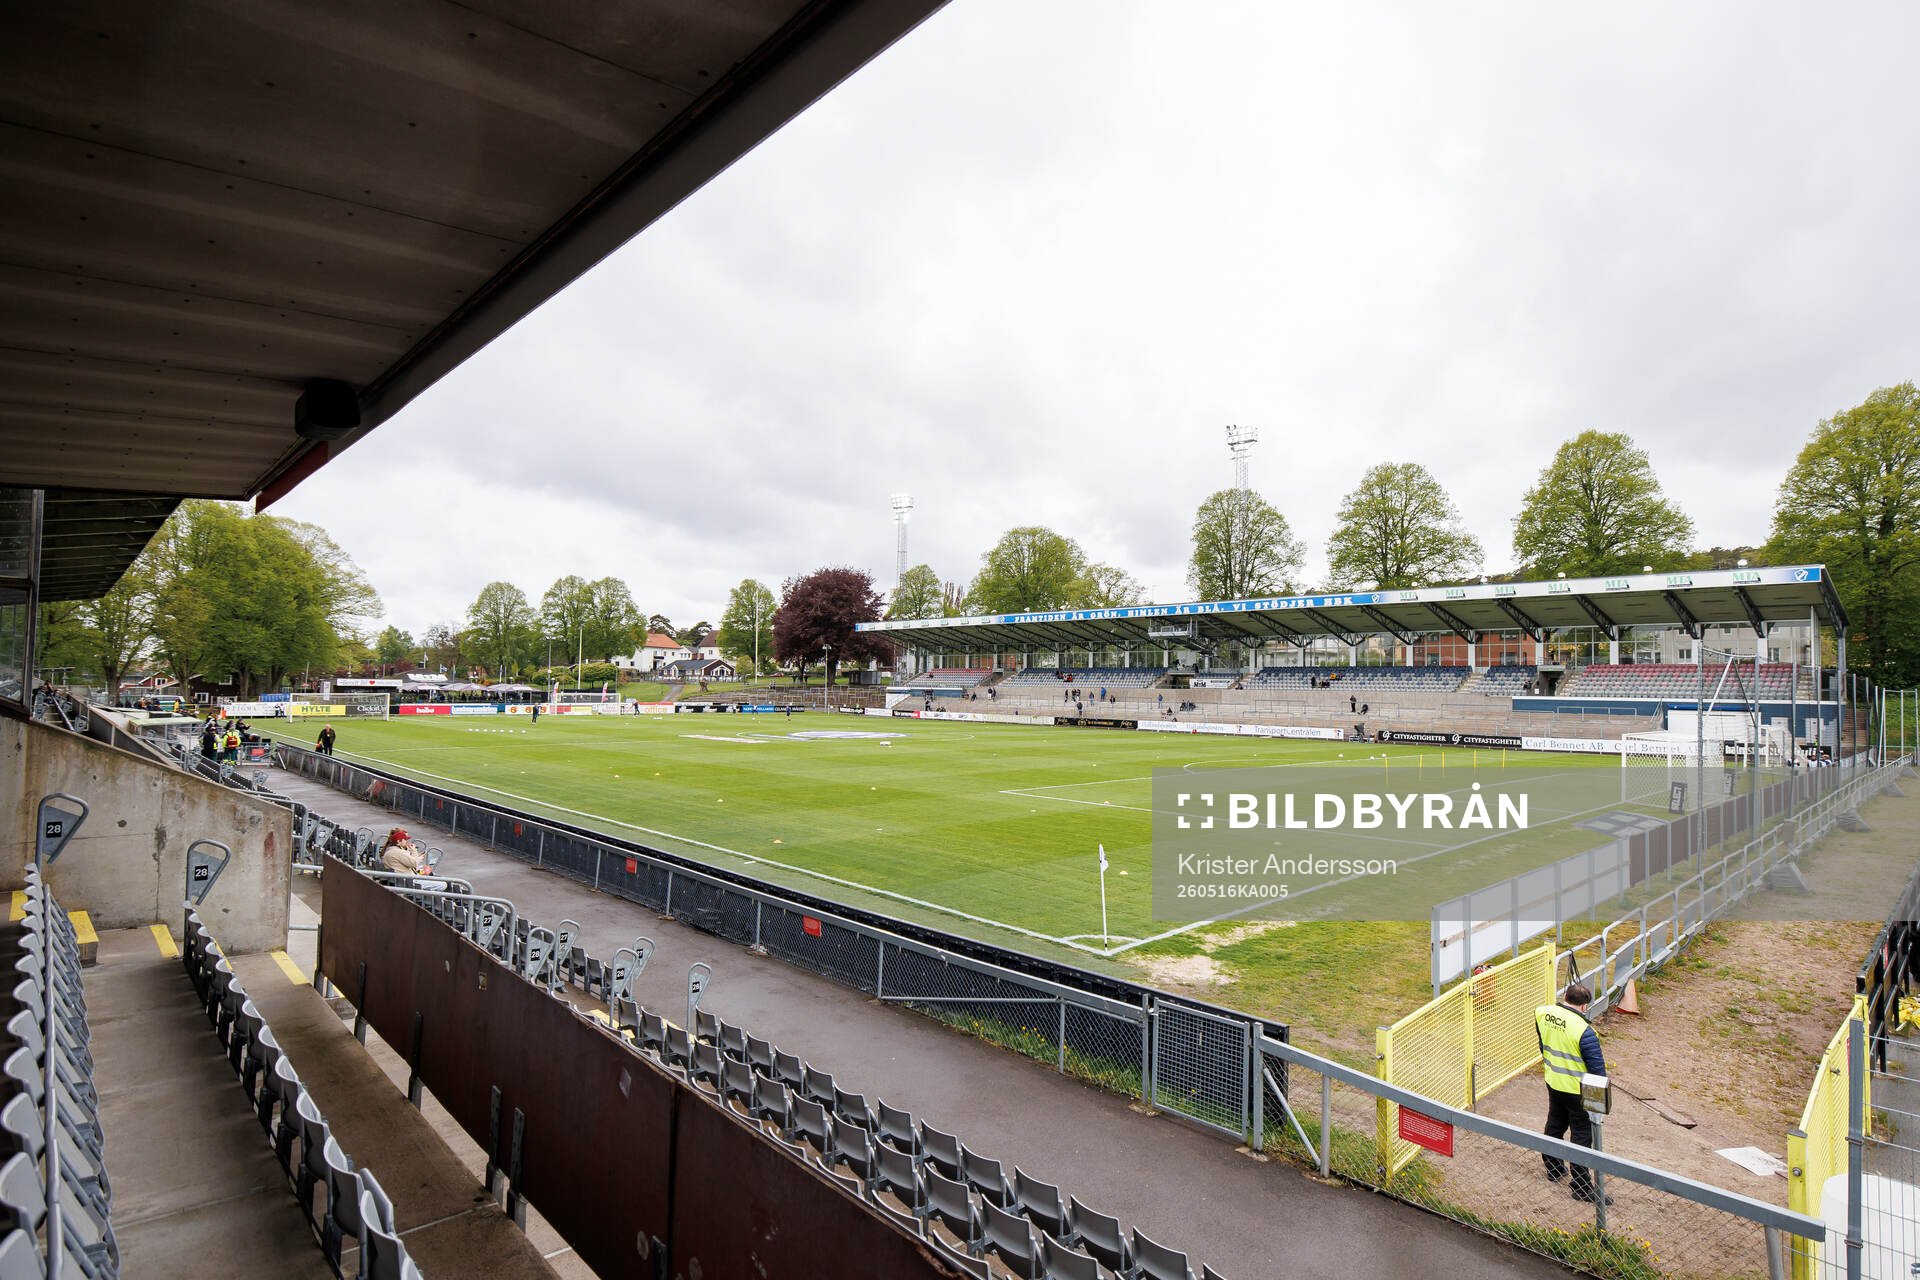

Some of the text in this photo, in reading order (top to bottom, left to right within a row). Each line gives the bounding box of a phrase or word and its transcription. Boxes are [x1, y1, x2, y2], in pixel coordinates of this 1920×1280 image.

[1014, 613, 1066, 623] FRAMTIDEN
[1233, 603, 1247, 611] VI
[1254, 598, 1314, 610] STÖDJER
[1323, 597, 1353, 606] HBK
[1393, 733, 1446, 742] CITYFASTIGHETER
[1463, 737, 1521, 746] CITYFASTIGHETER
[1525, 739, 1604, 751] Carl Bennet AB
[47, 824, 61, 834] 28
[195, 867, 208, 877] 28
[1545, 1013, 1566, 1028] ORCA
